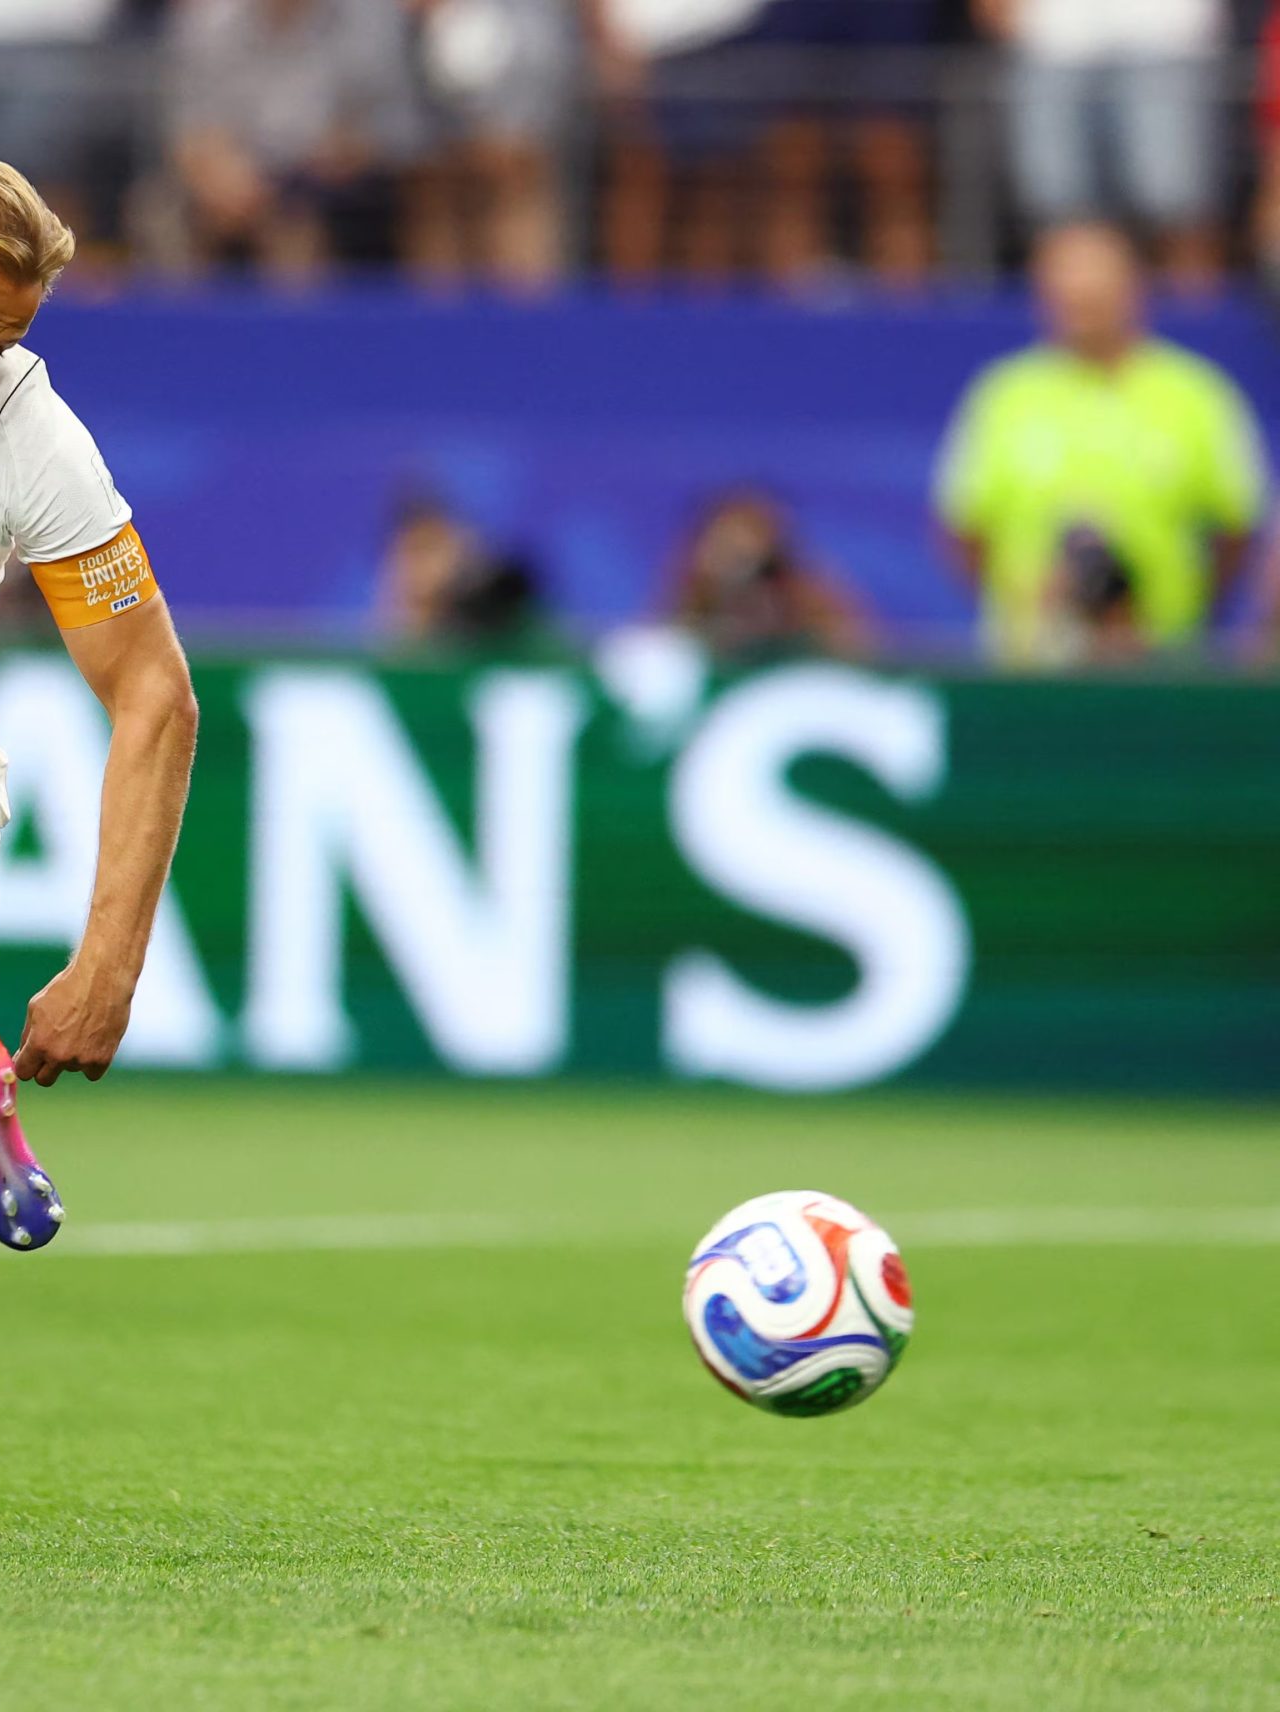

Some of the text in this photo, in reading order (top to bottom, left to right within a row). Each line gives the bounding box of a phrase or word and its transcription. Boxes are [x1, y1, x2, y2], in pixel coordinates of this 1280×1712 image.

[78, 534, 136, 572] FOOTBALL
[81, 546, 143, 589] UNITES
[84, 562, 150, 607] the World
[112, 595, 138, 611] FIFA
